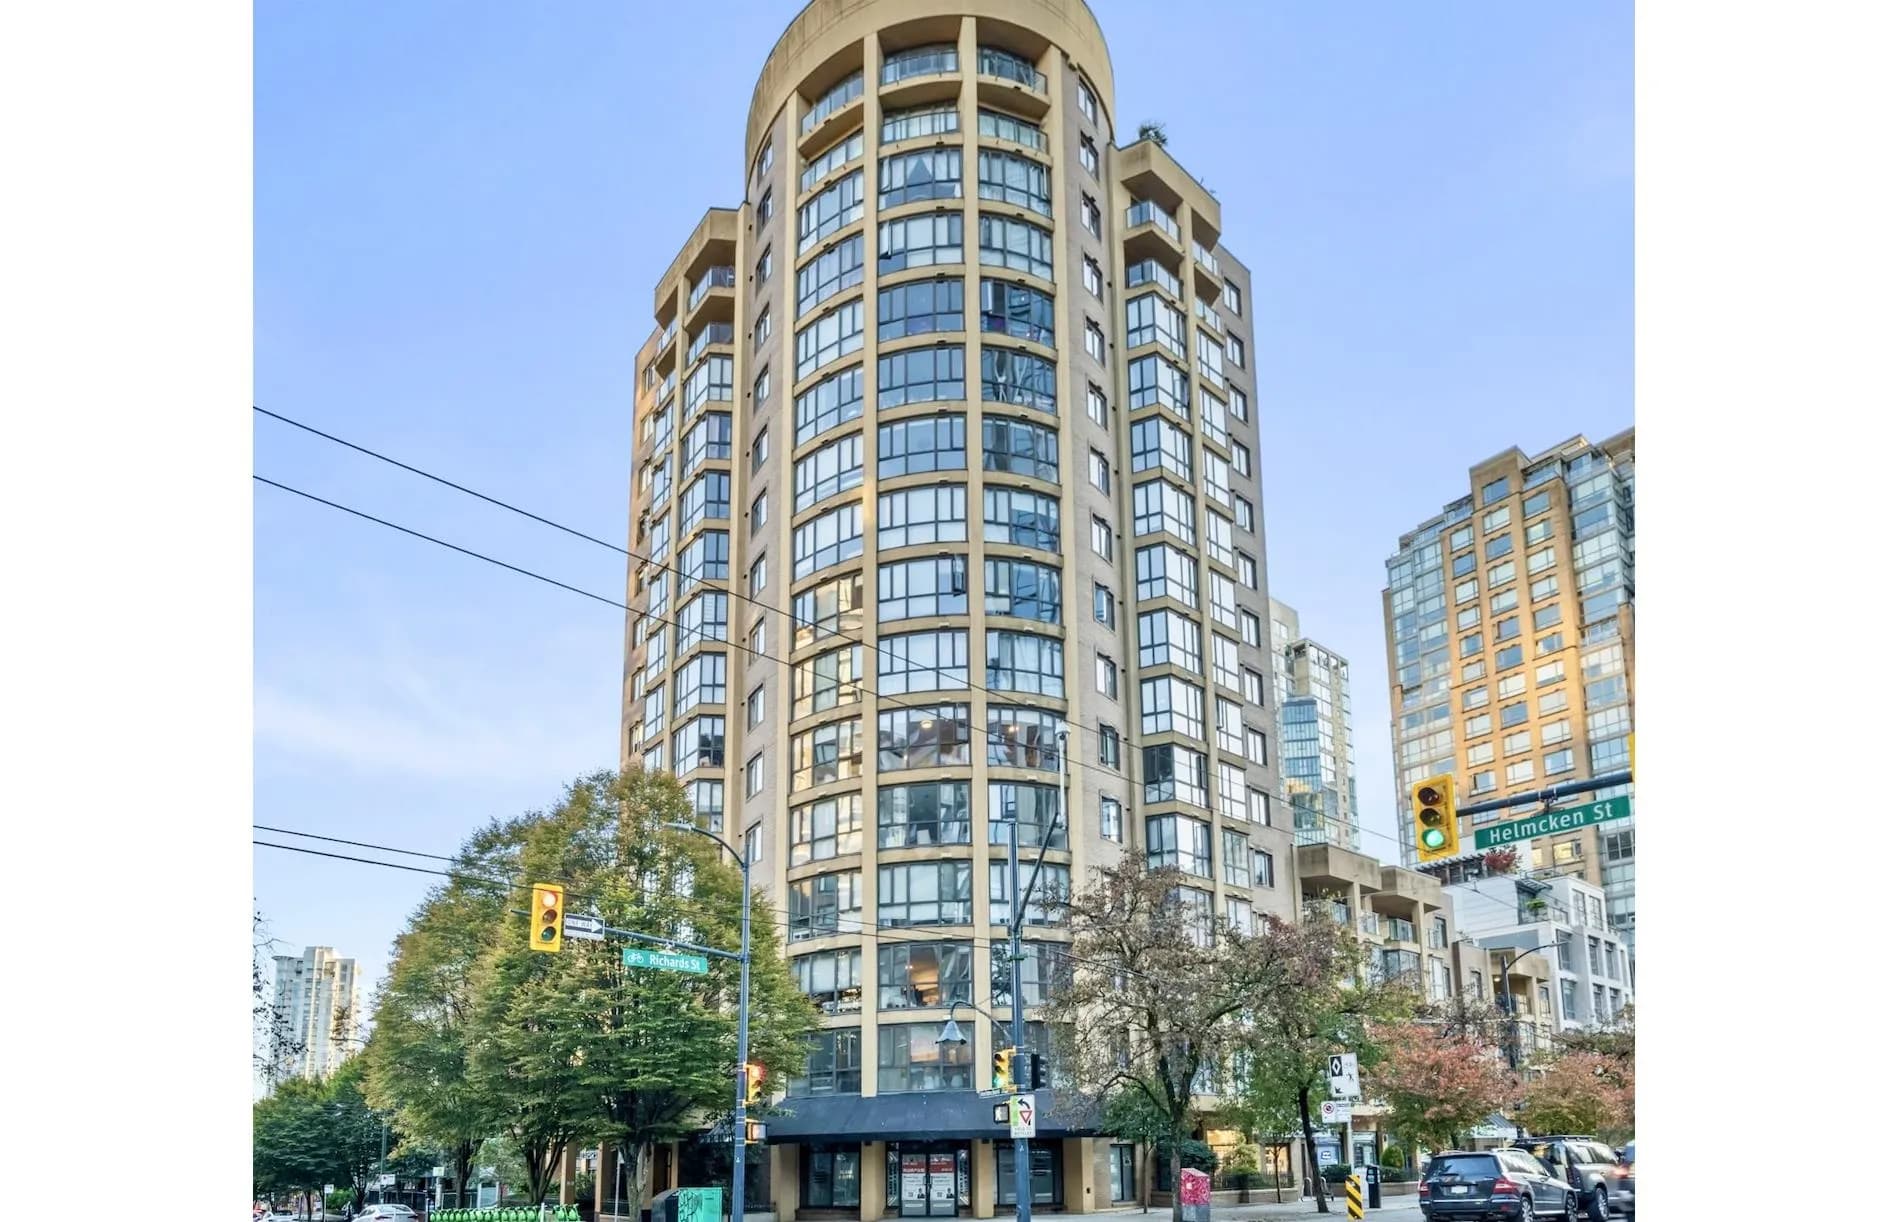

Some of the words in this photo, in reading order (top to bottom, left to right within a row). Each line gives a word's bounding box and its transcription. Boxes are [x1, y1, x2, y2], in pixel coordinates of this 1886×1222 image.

[1490, 810, 1584, 843] Helmcken
[1593, 803, 1614, 820] St
[649, 953, 690, 969] Richards
[690, 958, 701, 970] St
